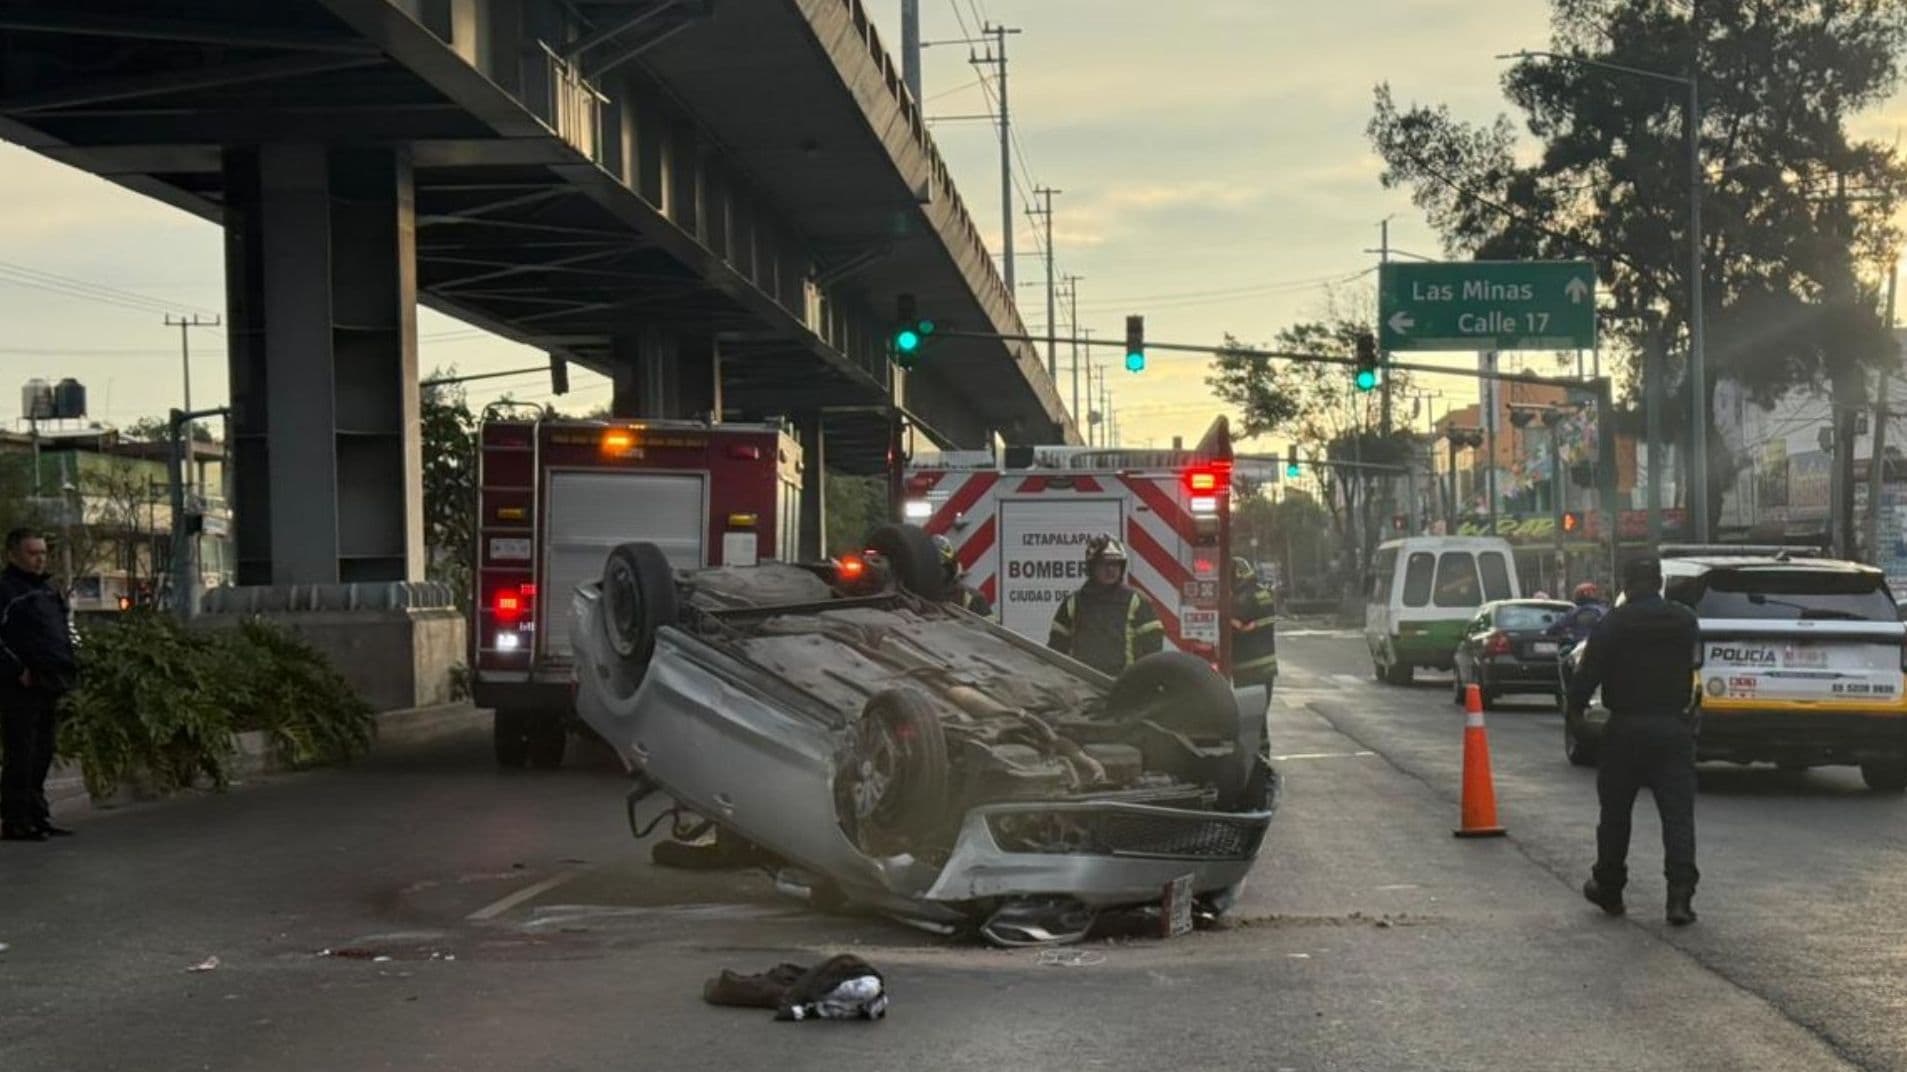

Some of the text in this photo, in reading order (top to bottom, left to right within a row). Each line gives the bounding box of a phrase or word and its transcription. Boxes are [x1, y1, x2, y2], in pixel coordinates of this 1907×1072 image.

[1412, 280, 1533, 301] Las Minas
[1458, 312, 1549, 333] Calle 17
[1008, 561, 1089, 578] BOMBER
[1009, 590, 1052, 602] CIUDAD
